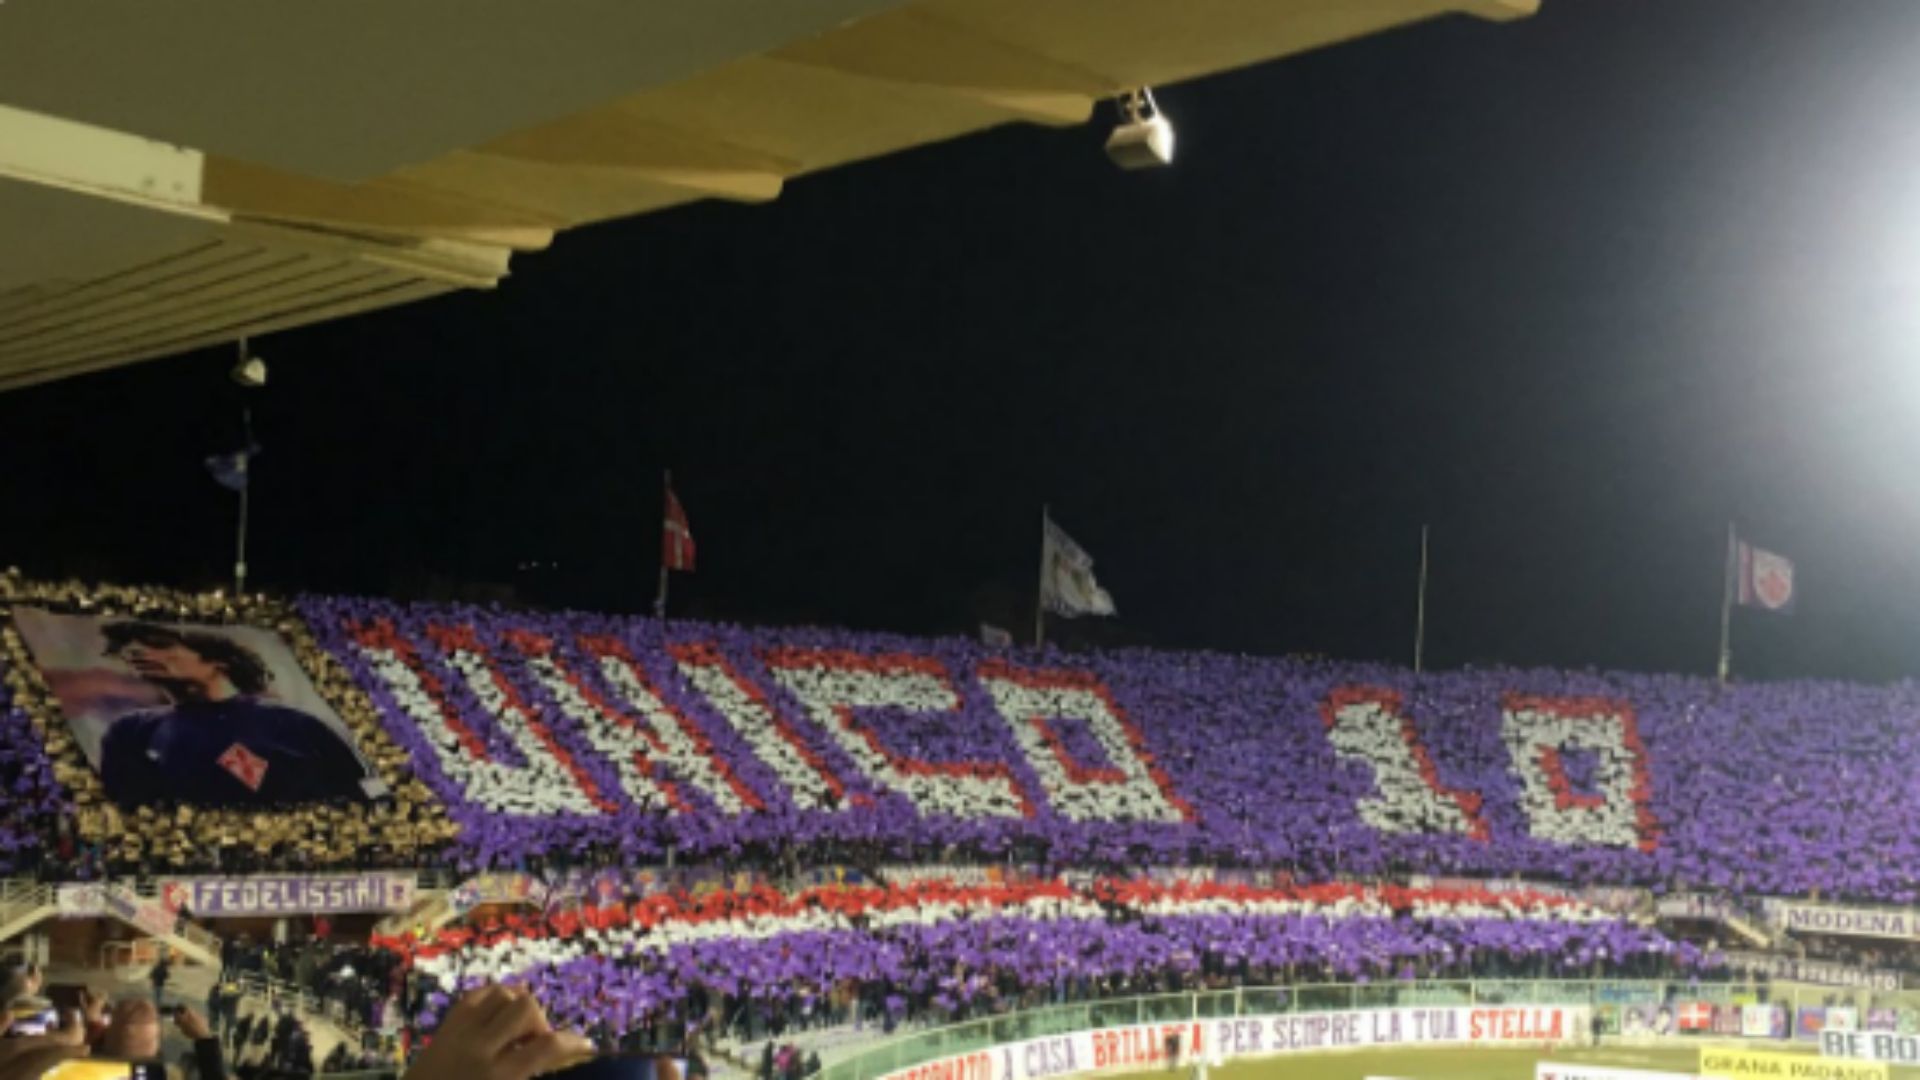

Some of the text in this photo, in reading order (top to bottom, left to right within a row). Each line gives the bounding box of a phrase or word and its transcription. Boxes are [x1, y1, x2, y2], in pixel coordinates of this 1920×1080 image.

[342, 616, 1662, 853] UNICO 10
[1218, 1021, 1263, 1052] PER
[1273, 1014, 1361, 1049] SEMPRE
[1373, 1009, 1400, 1043] LA
[1412, 1009, 1457, 1039] TUA
[1470, 1009, 1562, 1039] STELLA
[1703, 1055, 1783, 1074] GRANA
